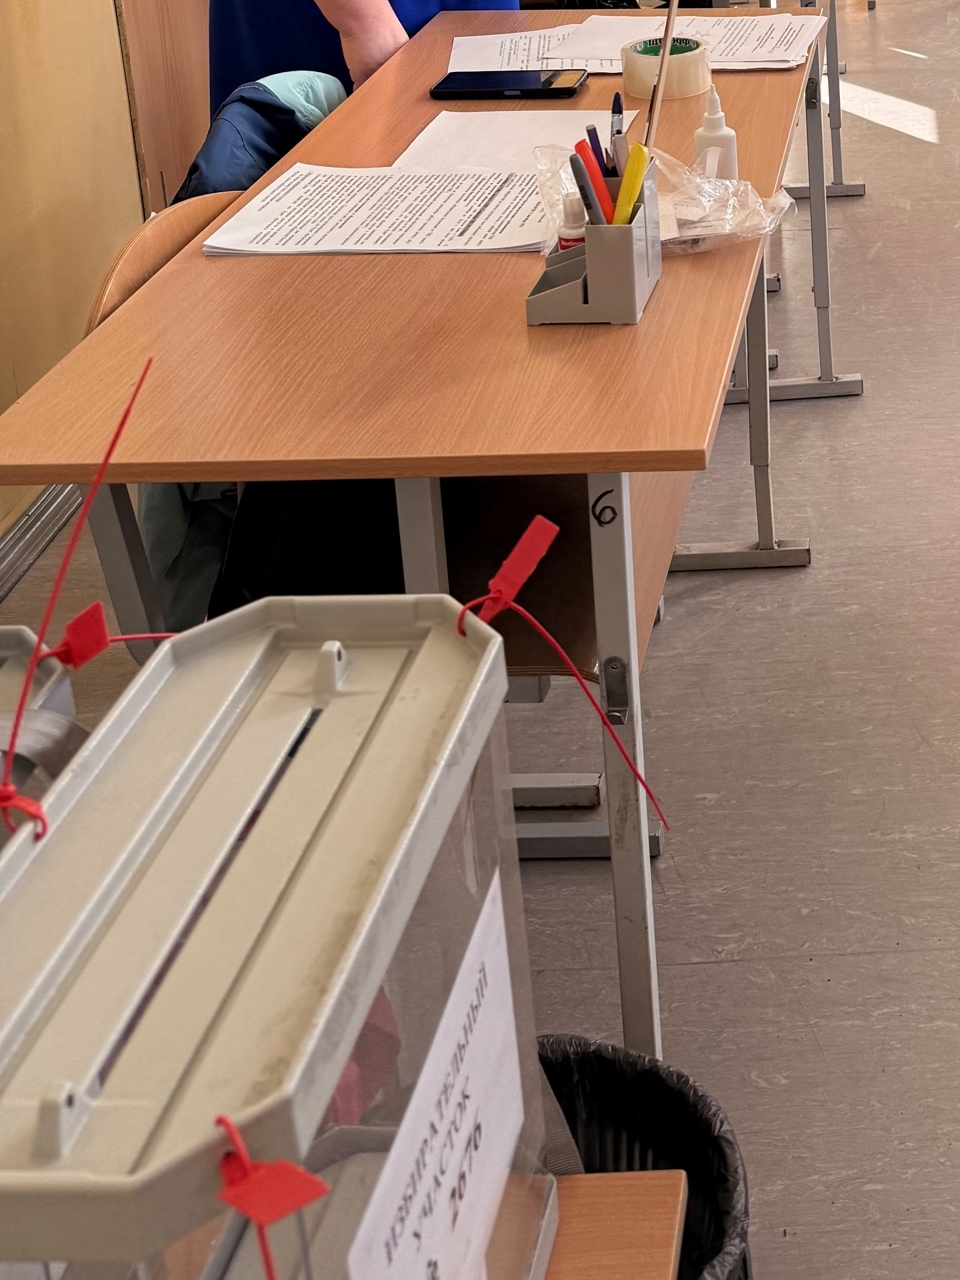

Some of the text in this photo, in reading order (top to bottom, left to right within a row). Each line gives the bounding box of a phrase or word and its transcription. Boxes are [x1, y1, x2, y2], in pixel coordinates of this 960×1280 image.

[591, 489, 618, 528] 6
[384, 960, 488, 1268] ИЗБИРАТЕЛЬНЫЙ
[413, 1075, 471, 1252] УЧАСТОК
[449, 1103, 482, 1234] 2676
